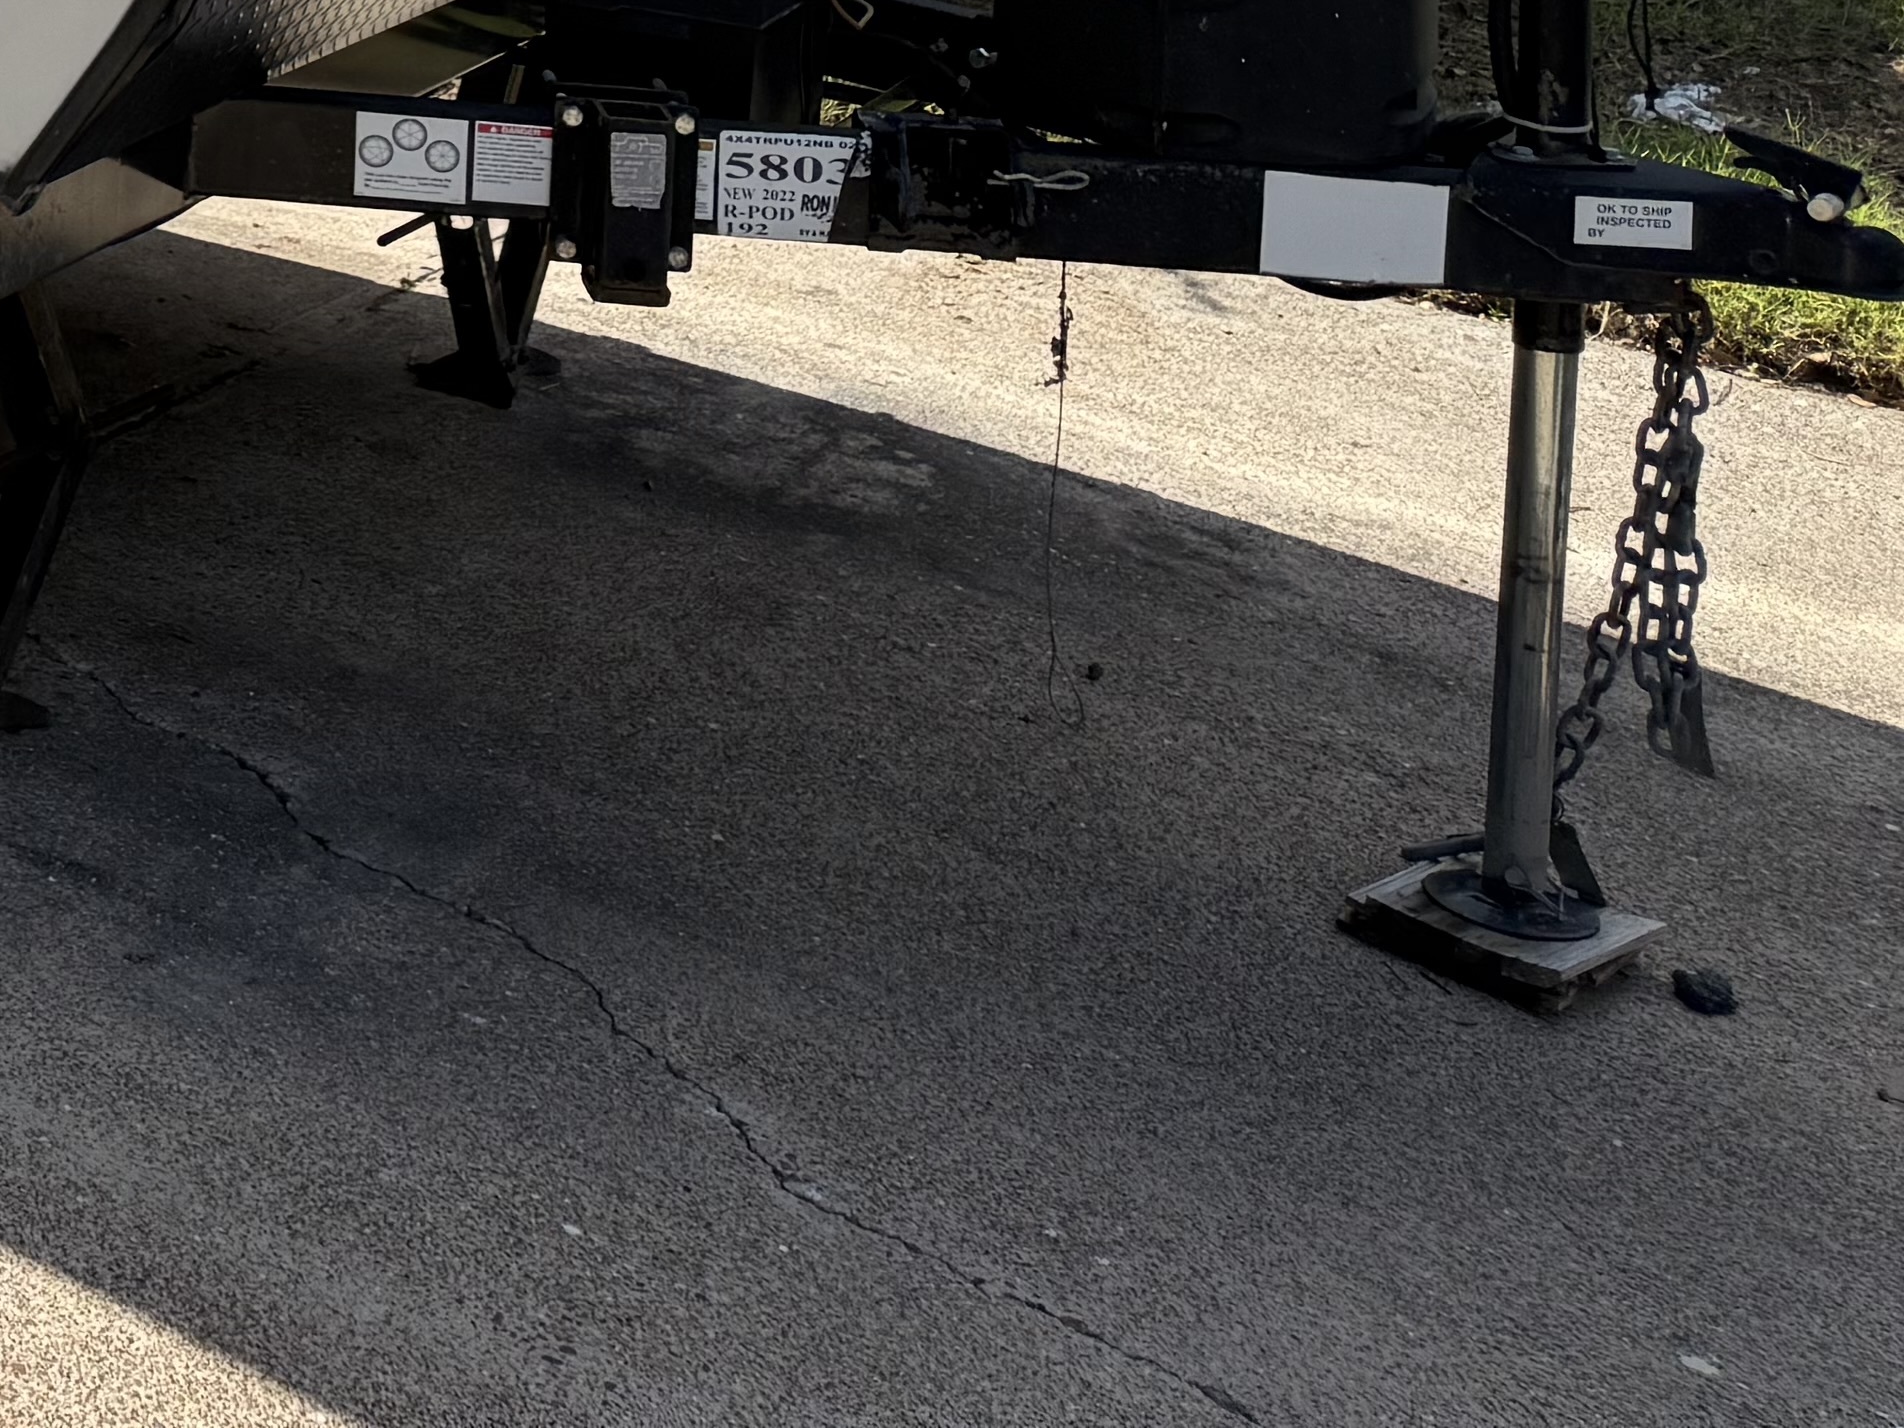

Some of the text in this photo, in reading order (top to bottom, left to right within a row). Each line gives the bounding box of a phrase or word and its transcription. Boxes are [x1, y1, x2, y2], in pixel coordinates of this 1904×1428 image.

[725, 152, 849, 185] 5803
[724, 187, 796, 202] NEW 2022
[801, 194, 831, 213] RON
[1597, 204, 1672, 216] OK TO SHIP
[724, 204, 795, 221] R-POD
[727, 222, 769, 236] 192
[1596, 216, 1672, 229] INSPECTED
[1587, 228, 1605, 237] BY
